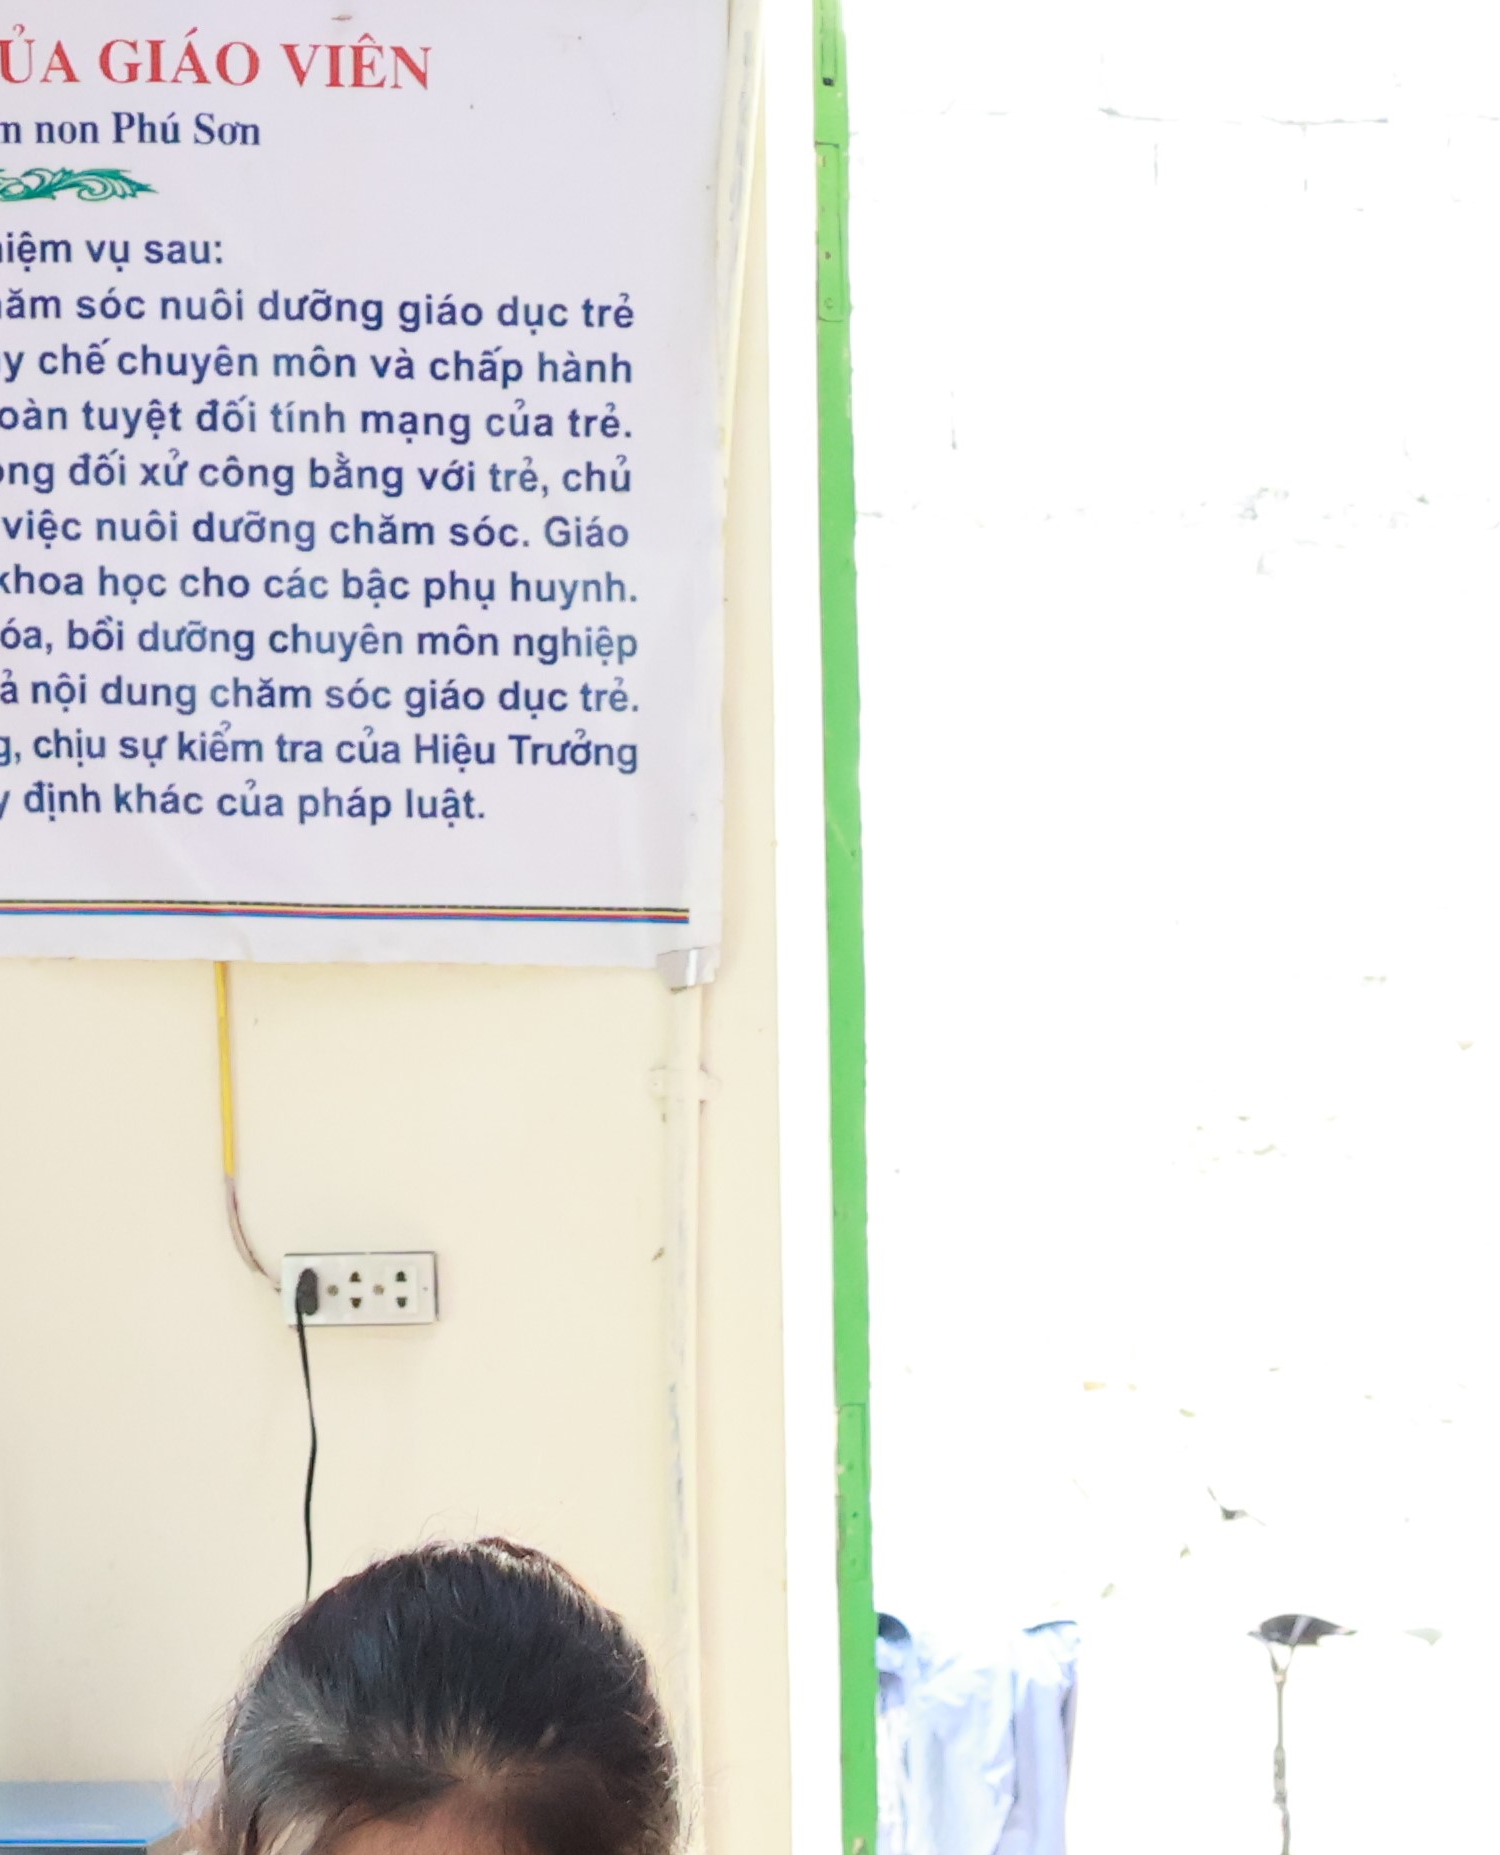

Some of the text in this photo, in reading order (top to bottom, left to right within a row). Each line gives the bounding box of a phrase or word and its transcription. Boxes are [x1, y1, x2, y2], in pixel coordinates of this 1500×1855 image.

[98, 26, 260, 86] GIÁO
[280, 32, 432, 90] VIÊN
[34, 121, 100, 145] non
[111, 111, 182, 145] Phú
[193, 112, 261, 146] Sơn
[84, 239, 130, 273] vụ
[144, 239, 223, 265] sau:
[75, 286, 146, 320] sóc
[160, 287, 244, 322] nuôi
[258, 287, 384, 332] dưỡng
[398, 293, 484, 334] giáo
[496, 295, 569, 337] dục
[580, 292, 635, 329] trẻ
[37, 337, 111, 376] chế
[116, 343, 259, 386] chuyên
[272, 344, 357, 378] môn
[369, 346, 415, 381] và
[428, 345, 524, 390] chấp
[537, 350, 632, 384] hành
[81, 398, 183, 441] tuyệt
[195, 394, 257, 433] đối
[269, 400, 346, 434] tính
[360, 409, 471, 446] mạng
[485, 398, 554, 438] của
[567, 401, 632, 439] trẻ.
[23, 779, 102, 823] định
[113, 782, 204, 816] khác
[216, 778, 285, 818] của
[298, 786, 392, 827] pháp
[405, 786, 485, 829] luật.
